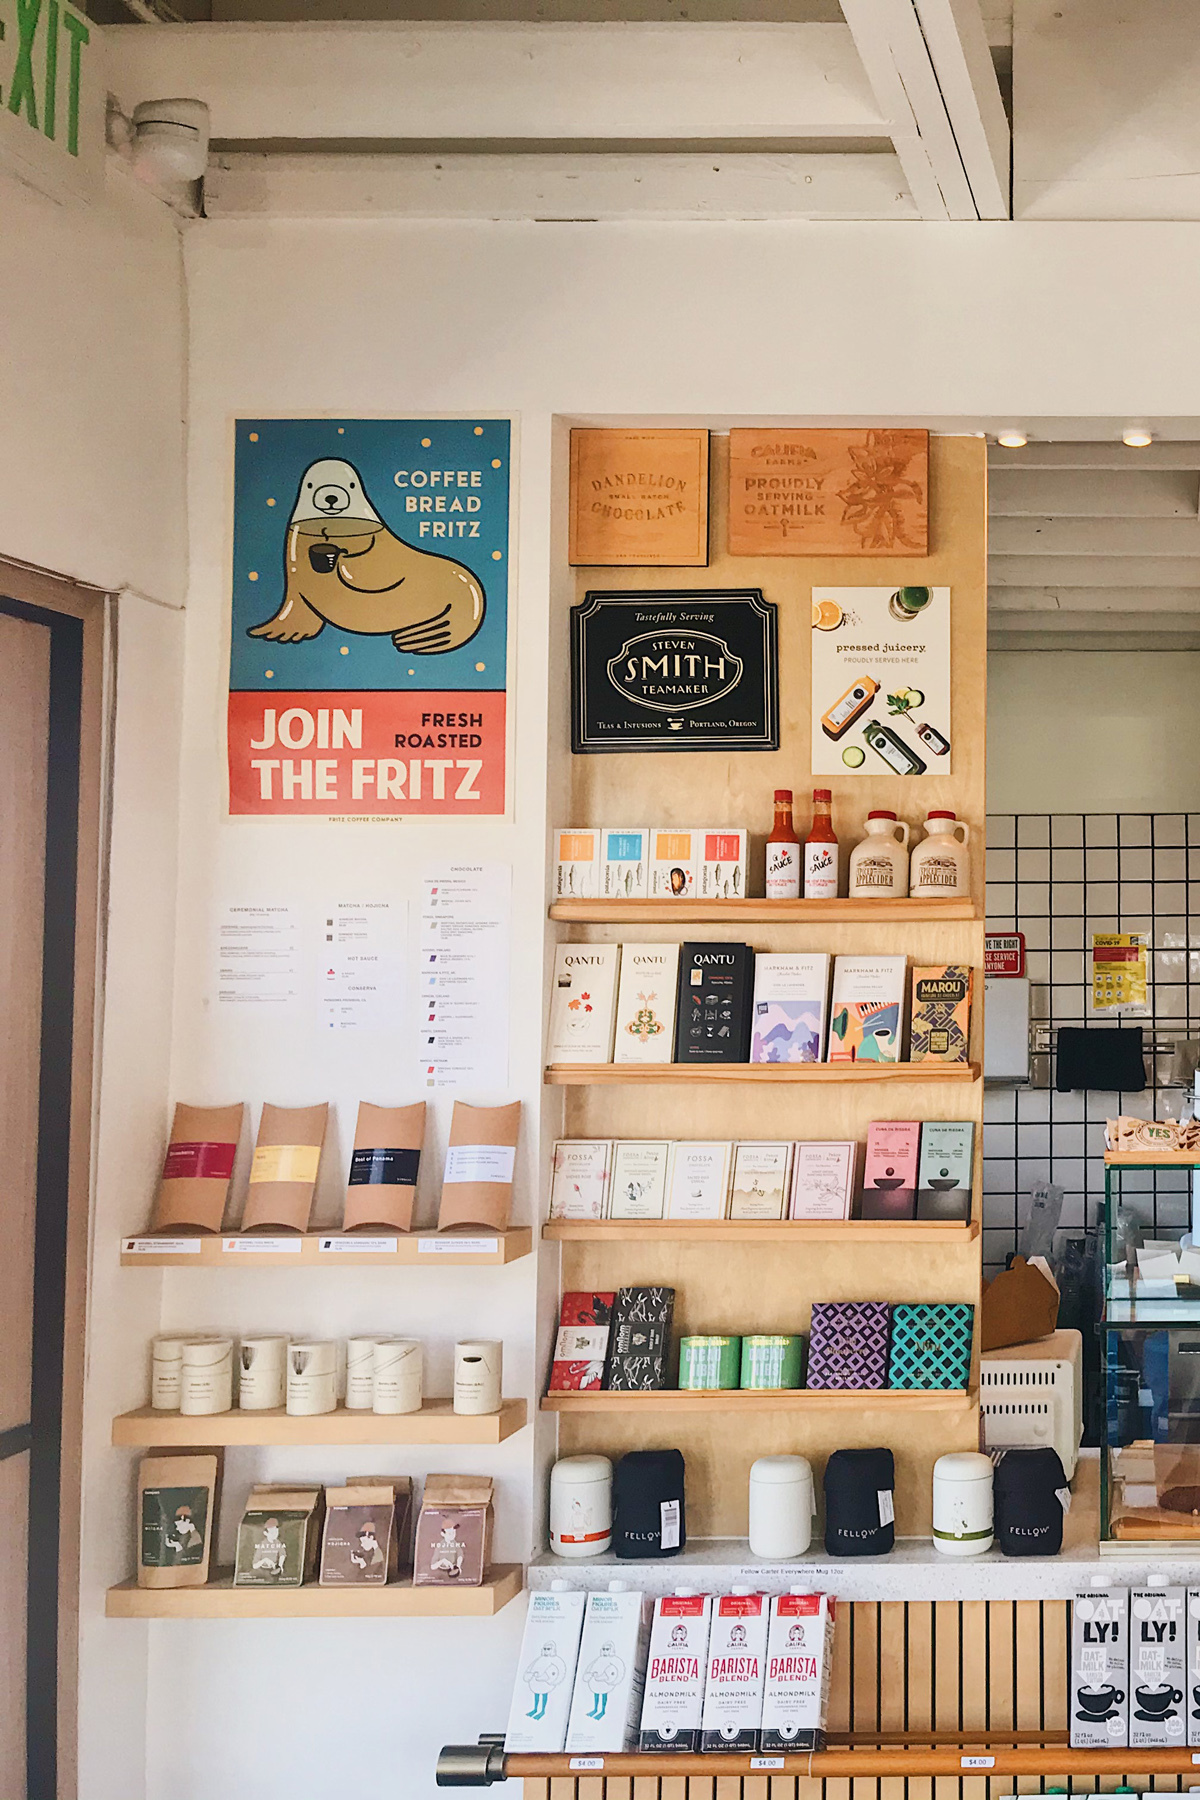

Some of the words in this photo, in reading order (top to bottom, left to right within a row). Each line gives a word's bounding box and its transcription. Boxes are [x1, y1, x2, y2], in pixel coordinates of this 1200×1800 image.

[0, 0, 90, 157] XIT
[394, 471, 482, 488] COFFEE
[591, 473, 687, 493] DANDELION
[744, 477, 825, 491] PROUDLY
[757, 492, 814, 501] SERVING
[405, 497, 482, 513] BREAD
[591, 500, 687, 521] CHOCOLATE
[744, 504, 826, 516] OATMILK
[419, 521, 481, 538] FRITZ
[634, 612, 678, 624] Tastefully
[680, 612, 715, 622] Serving
[652, 640, 695, 650] STEVEN
[836, 644, 880, 654] pressed
[624, 654, 725, 682] SMITH
[642, 684, 709, 694] TEAMAKER
[422, 713, 483, 728] FRESH
[250, 708, 363, 750] JOIN
[395, 734, 482, 749] ROASTED
[250, 759, 338, 800] THE
[352, 758, 483, 800] FRITZ
[769, 856, 793, 874] SAUCE
[809, 856, 834, 874] SAUCE
[993, 940, 1002, 949] THE
[1004, 940, 1018, 949] RIGHT
[565, 956, 604, 967] QANTU
[633, 956, 667, 966] QANTU
[693, 954, 735, 966] QANTU
[920, 981, 961, 994] MAROU
[1148, 1128, 1171, 1139] YES
[838, 1528, 877, 1538] FELLOW
[1010, 1526, 1049, 1537] FELLOW
[1084, 1621, 1119, 1642] LY!
[1141, 1621, 1176, 1642] LY!
[650, 1658, 698, 1679] BARISTA
[711, 1658, 758, 1679] BARISTA
[770, 1658, 817, 1679] BARISTA
[1082, 1661, 1105, 1671] MILK
[1140, 1660, 1162, 1671] MILK
